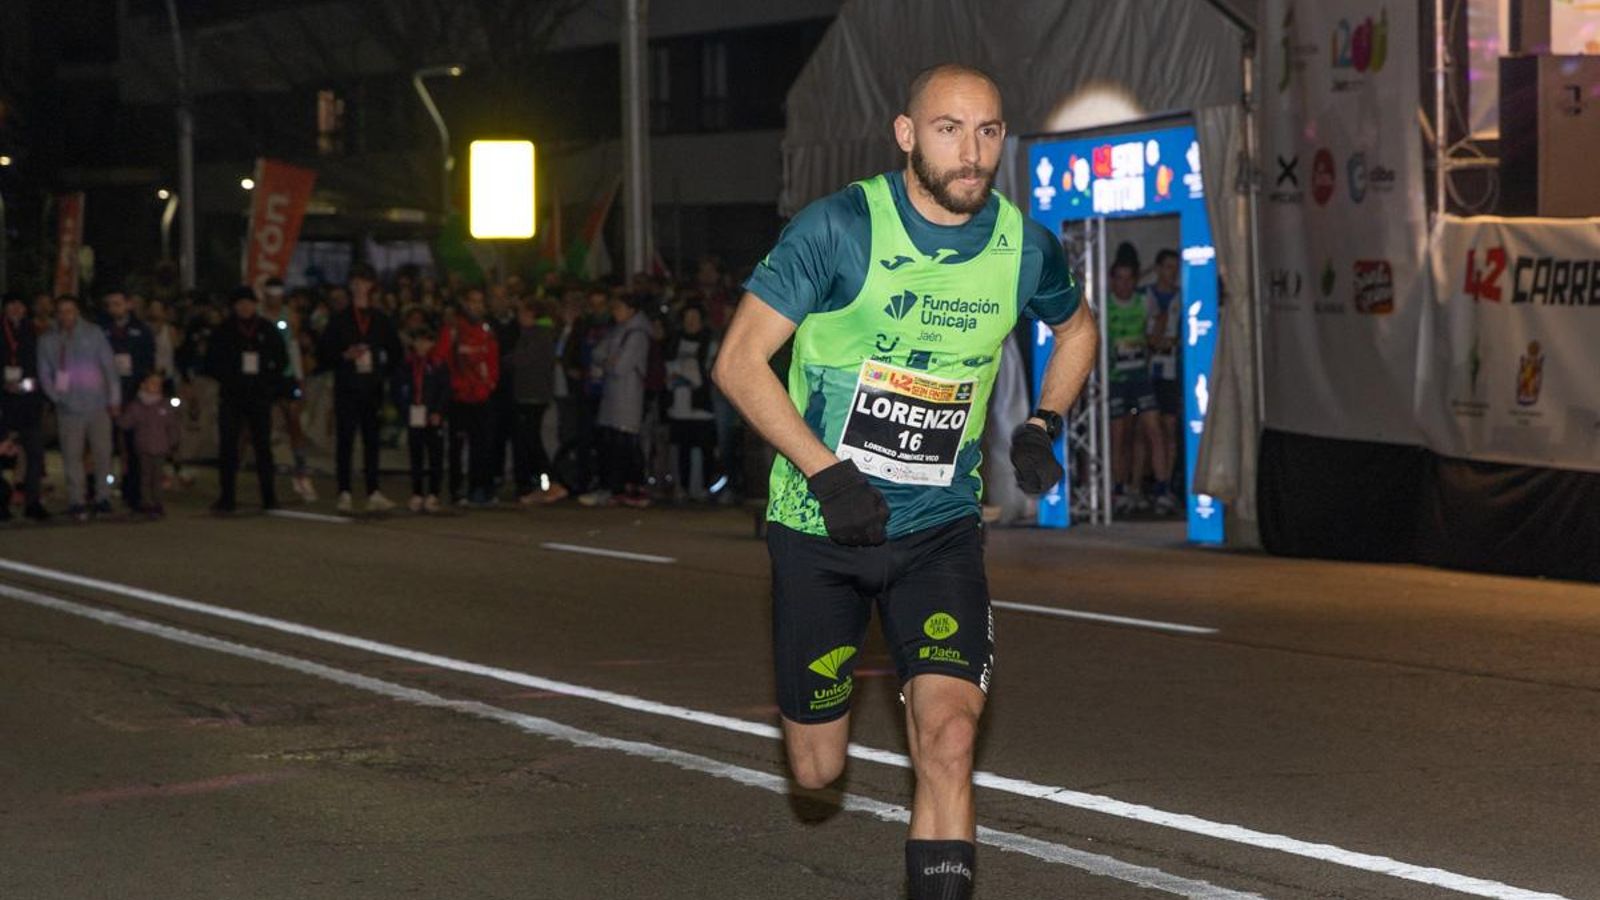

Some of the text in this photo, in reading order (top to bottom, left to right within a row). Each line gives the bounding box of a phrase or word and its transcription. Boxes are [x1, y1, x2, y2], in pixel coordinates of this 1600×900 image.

[1463, 246, 1507, 303] 42
[922, 294, 1000, 315] Fundación
[920, 310, 977, 333] Unicaja
[856, 393, 966, 430] LORENZO
[863, 440, 897, 457] LORENZO
[897, 430, 923, 451] 16
[923, 860, 972, 880] adida
